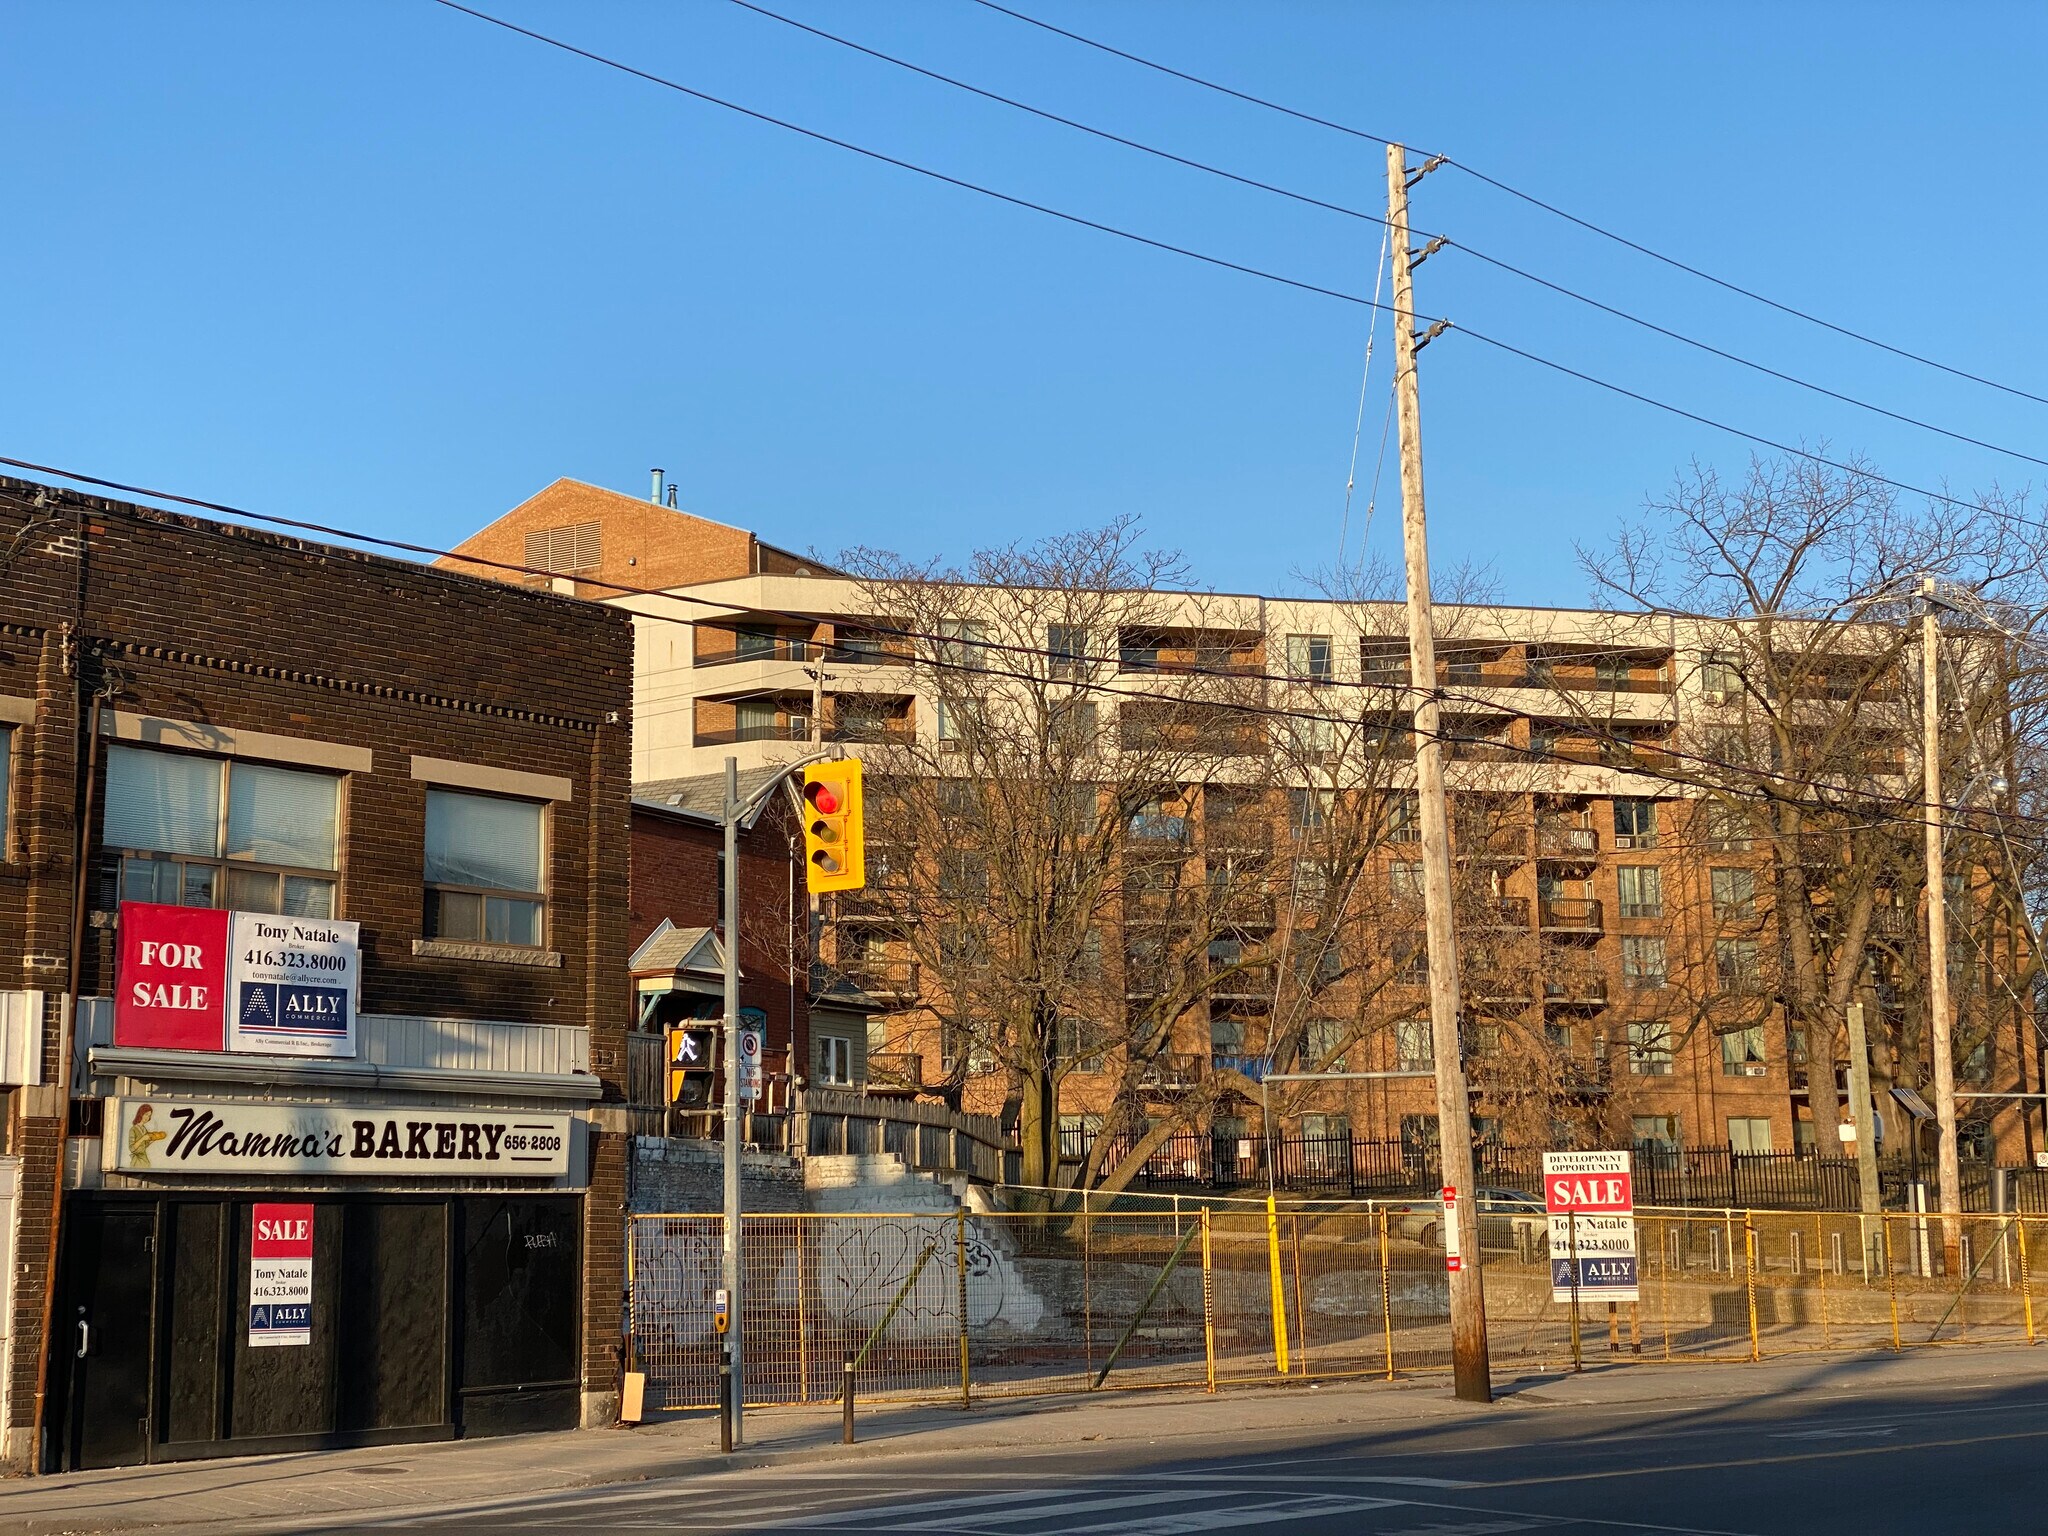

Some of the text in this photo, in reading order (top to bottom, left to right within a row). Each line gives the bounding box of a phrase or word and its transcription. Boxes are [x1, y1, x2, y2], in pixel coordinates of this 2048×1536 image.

[255, 923, 339, 943] Tony Natale
[139, 941, 203, 969] FOR
[244, 949, 346, 971] 416.323.8000
[132, 982, 208, 1010] SALE
[286, 994, 340, 1013] ALLY
[285, 1013, 341, 1022] COMMERCIAL
[746, 1067, 755, 1077] NO
[165, 1108, 346, 1160] Mamma's
[349, 1120, 506, 1161] BAKERY
[1550, 1155, 1622, 1163] DEVELOPMENT
[1552, 1163, 1621, 1172] OPPORTUNITY
[1553, 1180, 1625, 1206] SALE
[258, 1219, 308, 1241] SALE
[1552, 1217, 1628, 1232] Toy Natale
[254, 1269, 308, 1281] Tony Natale
[1588, 1263, 1631, 1276] ALLY
[253, 1286, 309, 1297] 416.323.8000
[275, 1308, 307, 1320] ALLY
